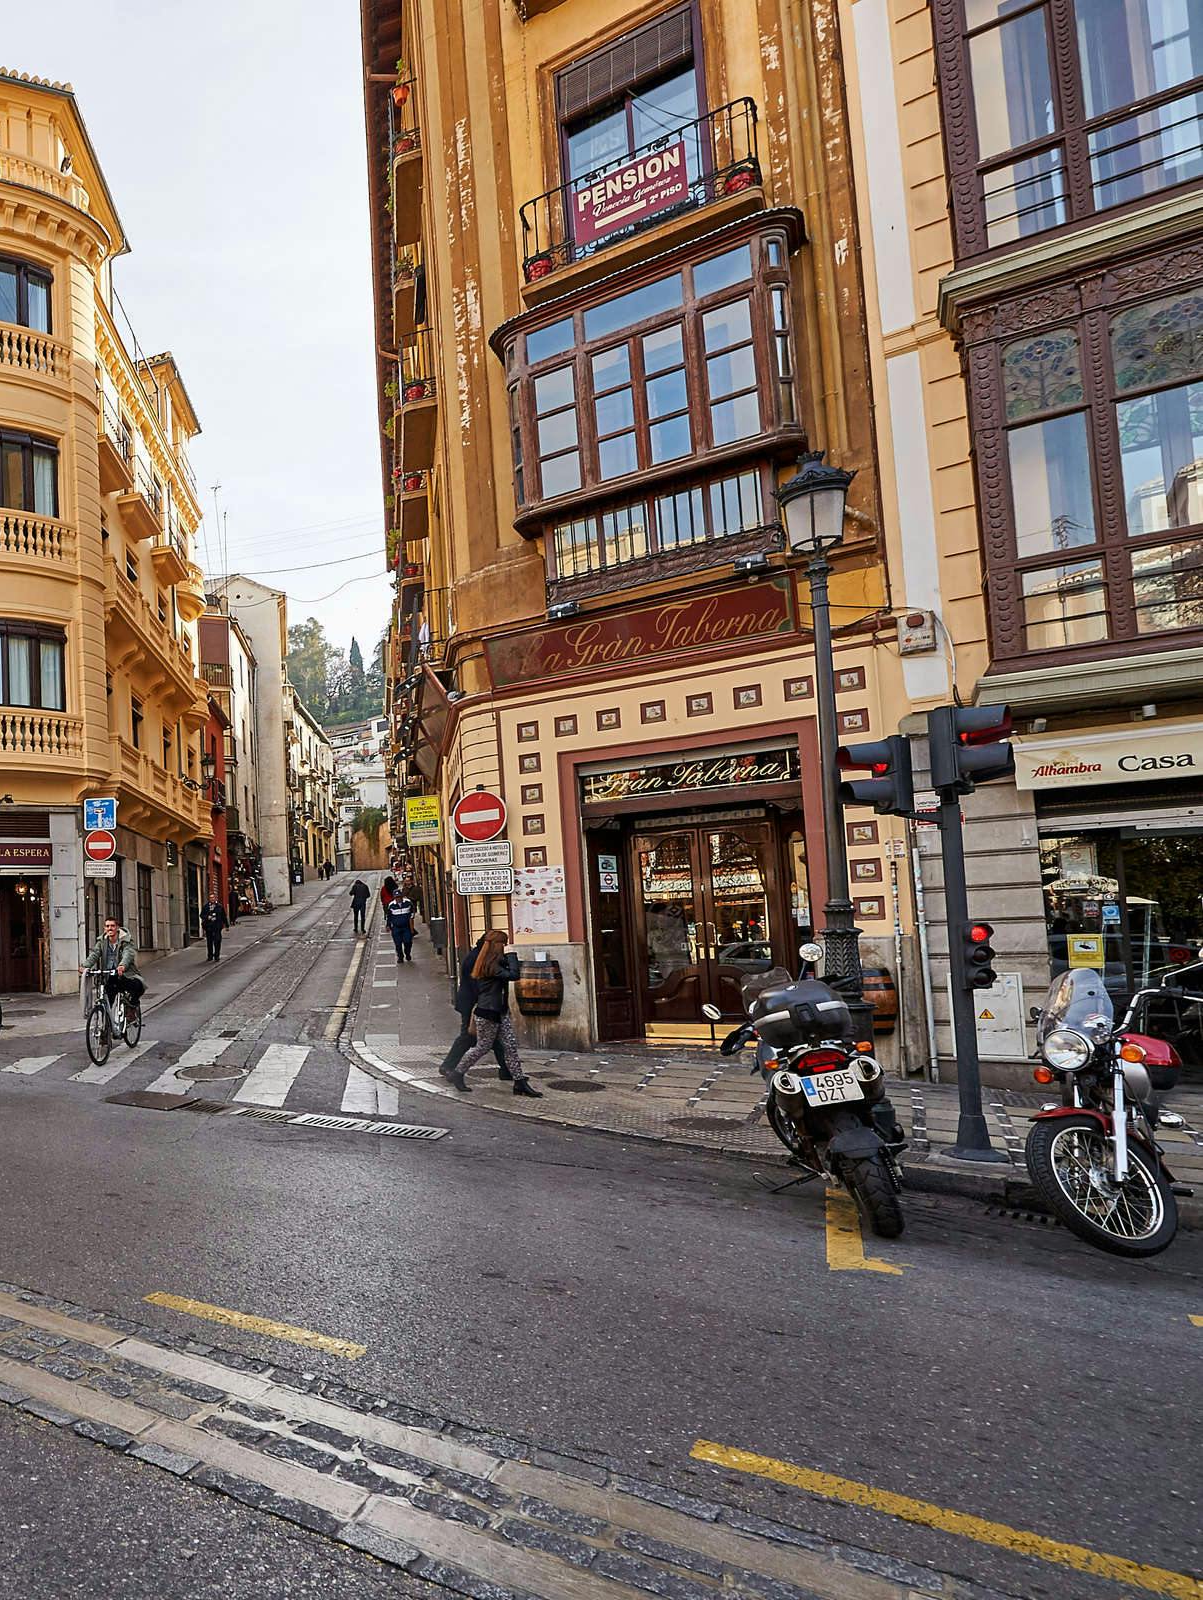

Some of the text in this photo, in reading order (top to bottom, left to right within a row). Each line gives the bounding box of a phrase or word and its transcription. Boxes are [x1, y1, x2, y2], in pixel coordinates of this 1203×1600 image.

[578, 147, 680, 212] PENSION
[660, 183, 682, 199] PISO
[650, 598, 783, 650] Taberna
[1031, 752, 1195, 779] Alhambra Casa
[598, 758, 781, 796] Gran Taberna
[13, 848, 50, 857] ESPERA
[817, 1072, 854, 1088] 4695
[818, 1087, 845, 1102] DZT
